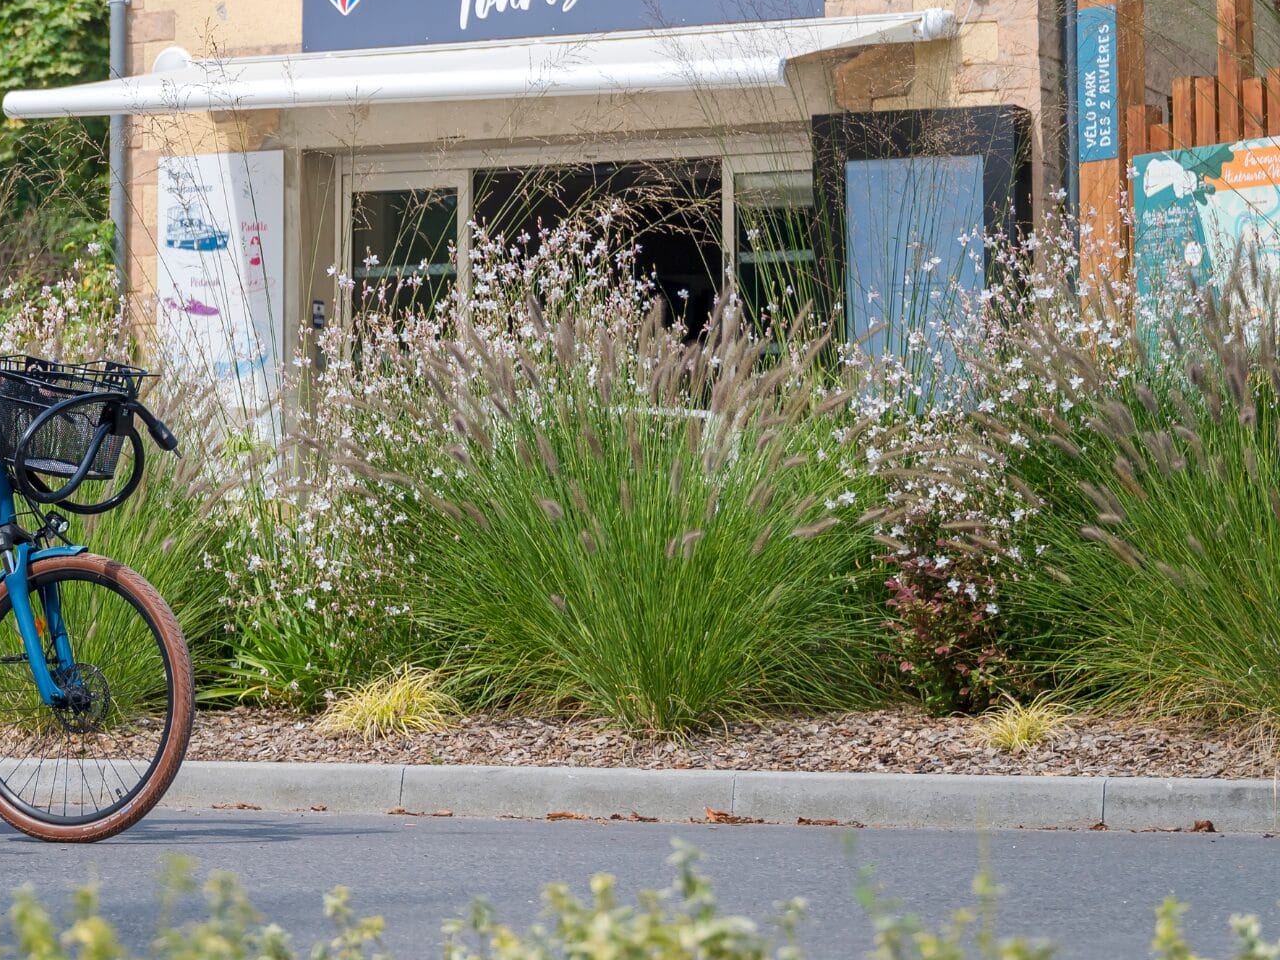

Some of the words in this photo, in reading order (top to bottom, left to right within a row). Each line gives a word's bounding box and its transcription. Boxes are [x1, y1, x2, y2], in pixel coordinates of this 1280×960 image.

[1097, 24, 1110, 94] RIVIÈRES
[1085, 70, 1096, 107] PARK
[1100, 100, 1111, 110] 2
[1084, 111, 1097, 148] VÉLO
[1099, 115, 1111, 147] DES
